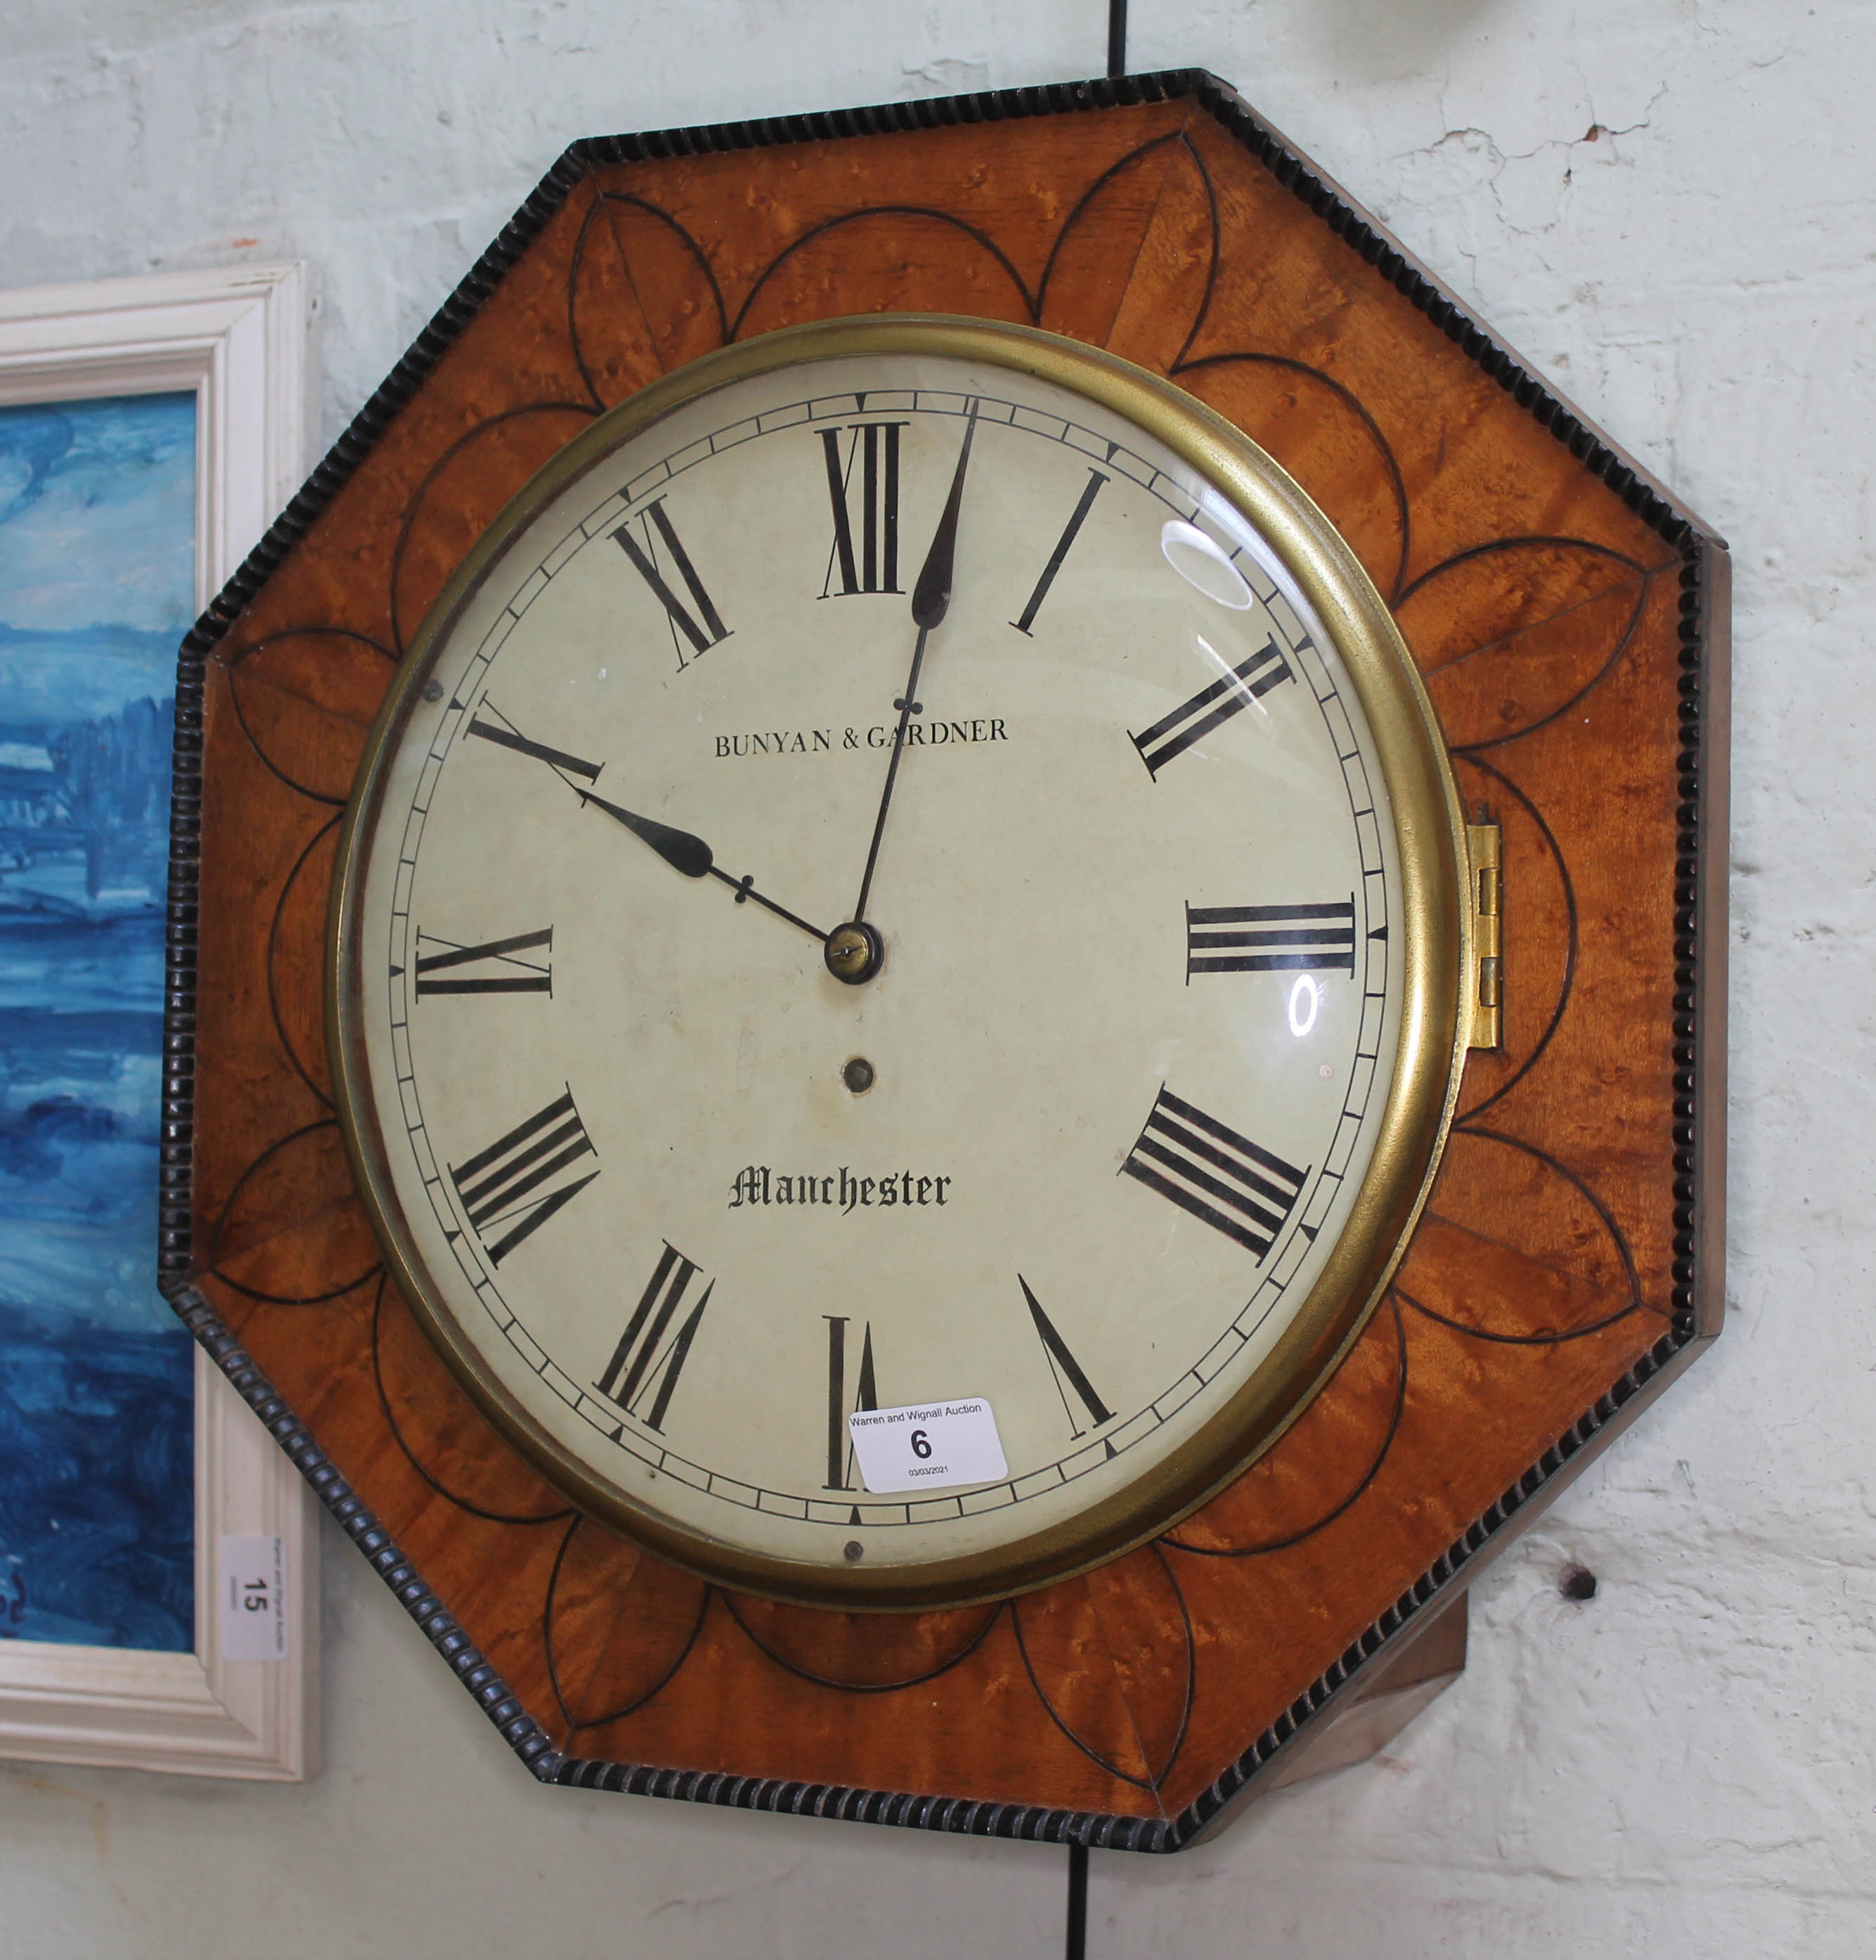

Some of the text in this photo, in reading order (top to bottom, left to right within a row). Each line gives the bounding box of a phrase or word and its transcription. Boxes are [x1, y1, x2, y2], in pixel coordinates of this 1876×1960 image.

[814, 422, 910, 599] XII
[1009, 466, 1111, 637] I
[606, 493, 735, 673] XI
[462, 689, 606, 808] X
[715, 718, 1009, 758] BUNYAN & GARDNER
[1127, 631, 1297, 783] II
[415, 924, 554, 1005] IX
[1185, 891, 1355, 987] III
[446, 1081, 602, 1271] VIII
[728, 1165, 952, 1216] Manchester
[1116, 1080, 1312, 1268] IIII
[592, 1238, 716, 1436] VII
[1017, 1273, 1118, 1441] V
[849, 1403, 982, 1427] Warren and Wignall Auction
[908, 1466, 949, 1477] 03/03/2021
[910, 1429, 932, 1459] 6
[244, 1578, 268, 1612] 15
